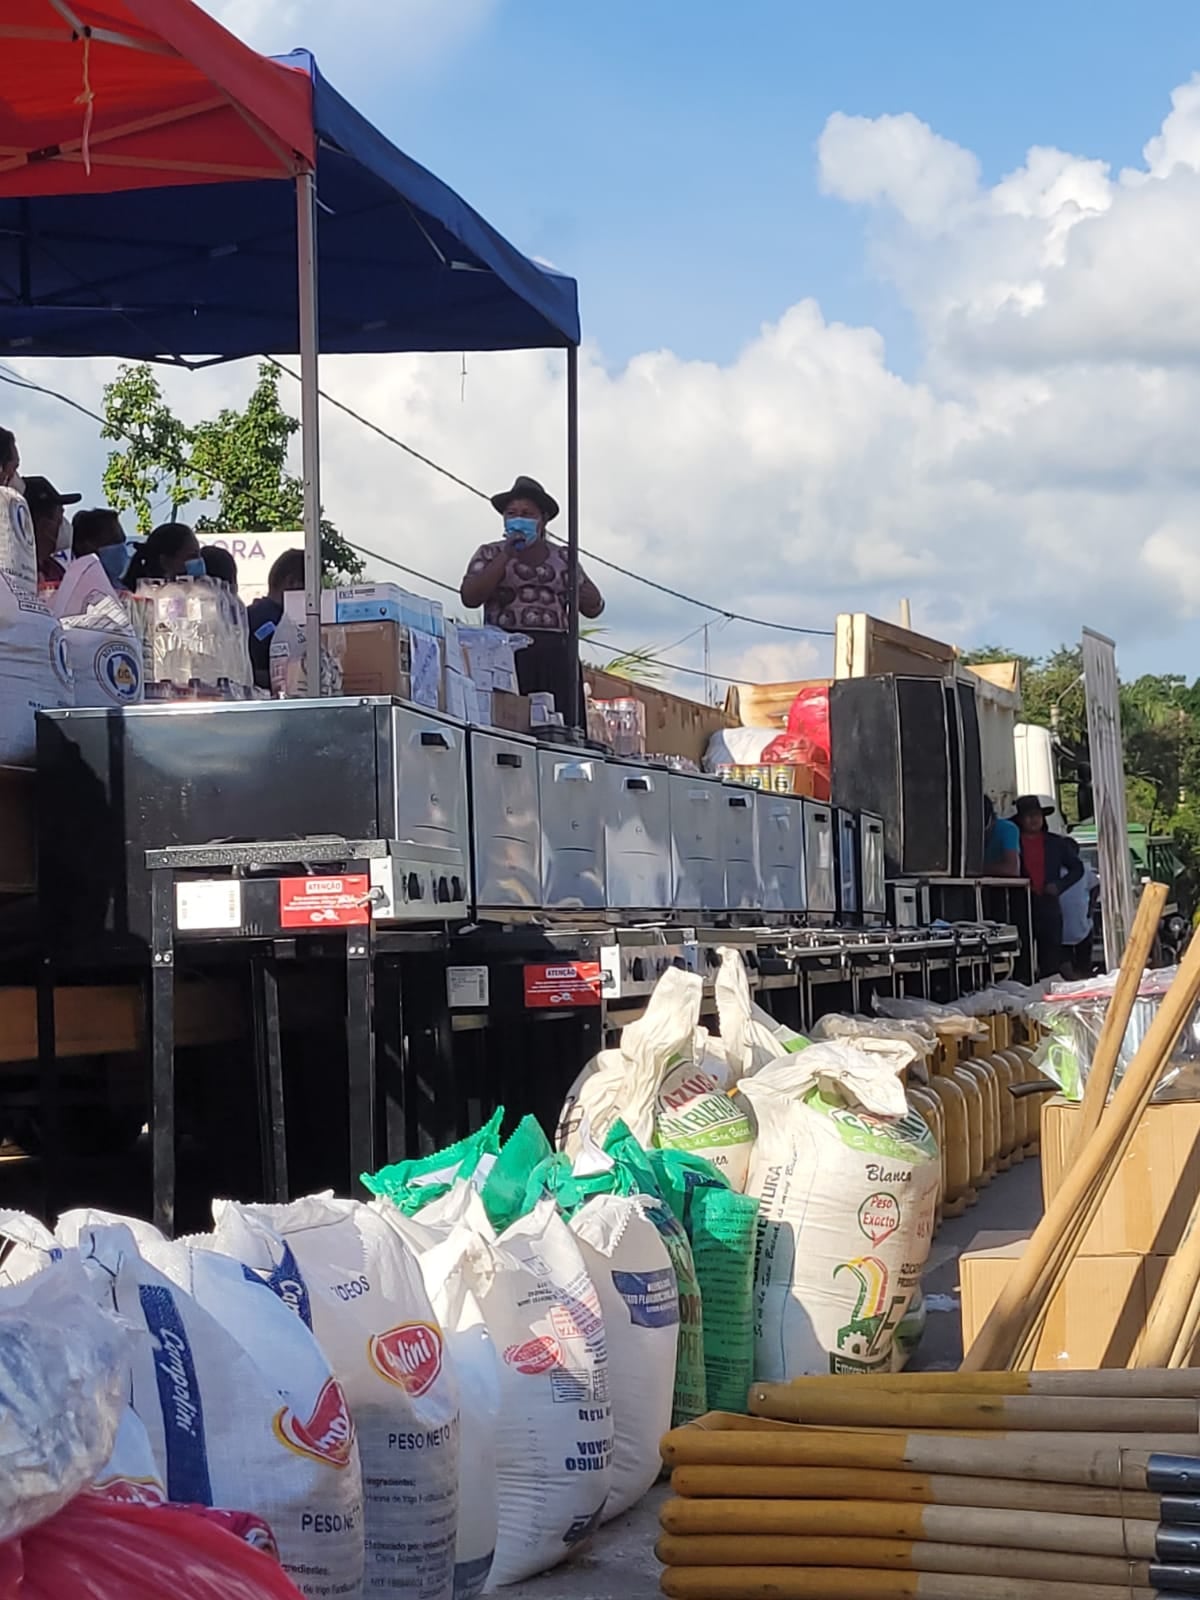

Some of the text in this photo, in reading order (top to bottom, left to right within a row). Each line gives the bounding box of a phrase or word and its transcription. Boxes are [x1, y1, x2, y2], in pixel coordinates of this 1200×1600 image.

[547, 968, 576, 977] ATENÇÃO
[865, 1163, 912, 1183] Blanca
[870, 1195, 893, 1209] Peso
[863, 1211, 896, 1228] Exacto
[159, 1327, 198, 1438] Campolini
[388, 1424, 450, 1450] PESO NETO
[565, 1456, 604, 1471] TRIGO
[302, 1513, 342, 1533] PESO
